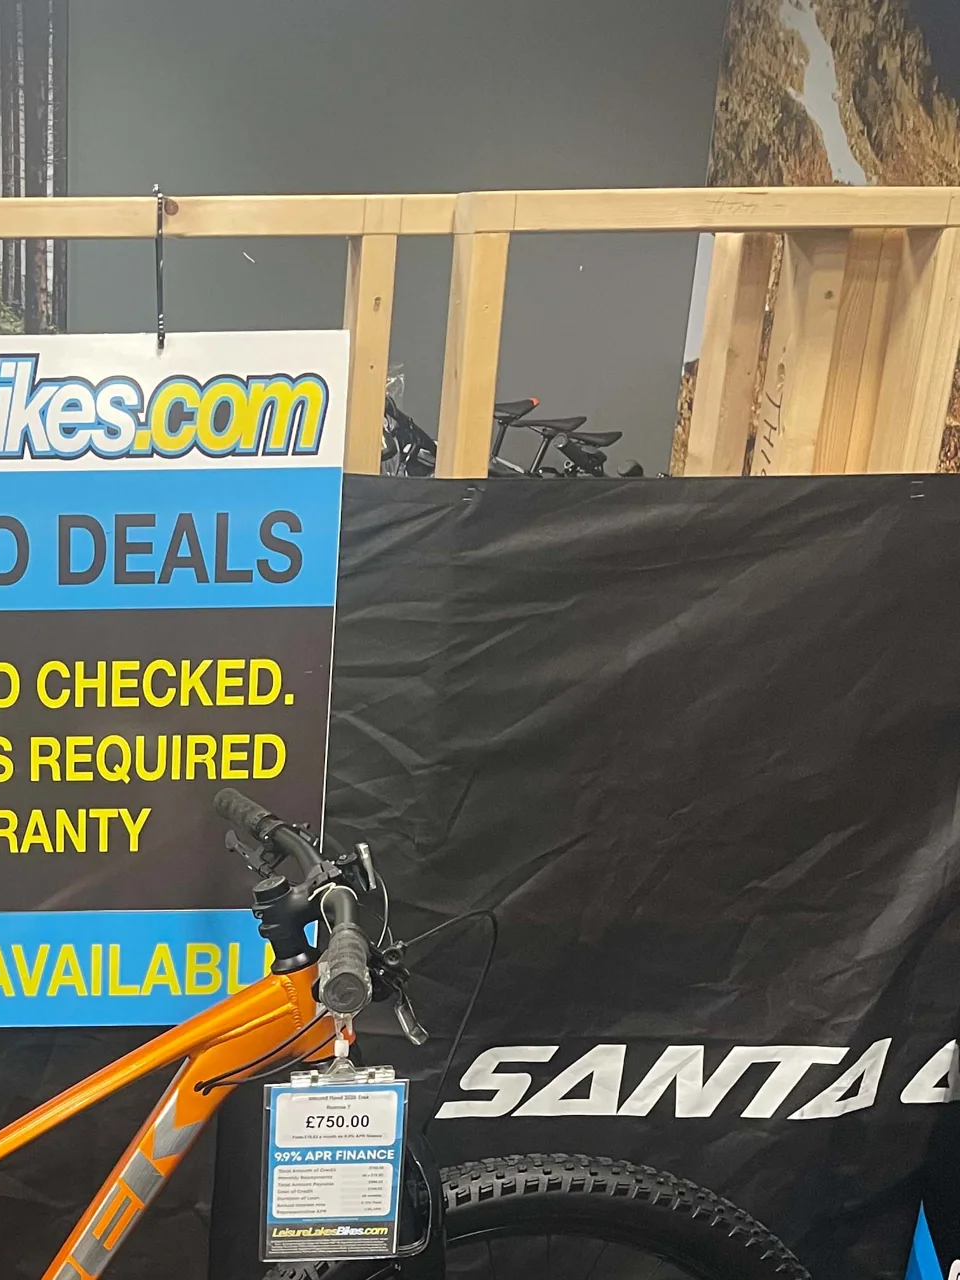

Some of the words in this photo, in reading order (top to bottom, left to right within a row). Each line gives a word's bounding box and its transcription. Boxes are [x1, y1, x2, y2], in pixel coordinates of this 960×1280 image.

[58, 509, 304, 587] DEALS
[36, 658, 295, 709] CHECKED.
[30, 733, 287, 784] REQUIRED
[434, 1037, 893, 1120] SANTA
[305, 1114, 370, 1129] £750.00
[274, 1151, 303, 1162] 9.9%
[304, 1150, 333, 1161] APR
[335, 1149, 395, 1161] FINANCE
[271, 1226, 389, 1238] LeisureLakesBikes.com
